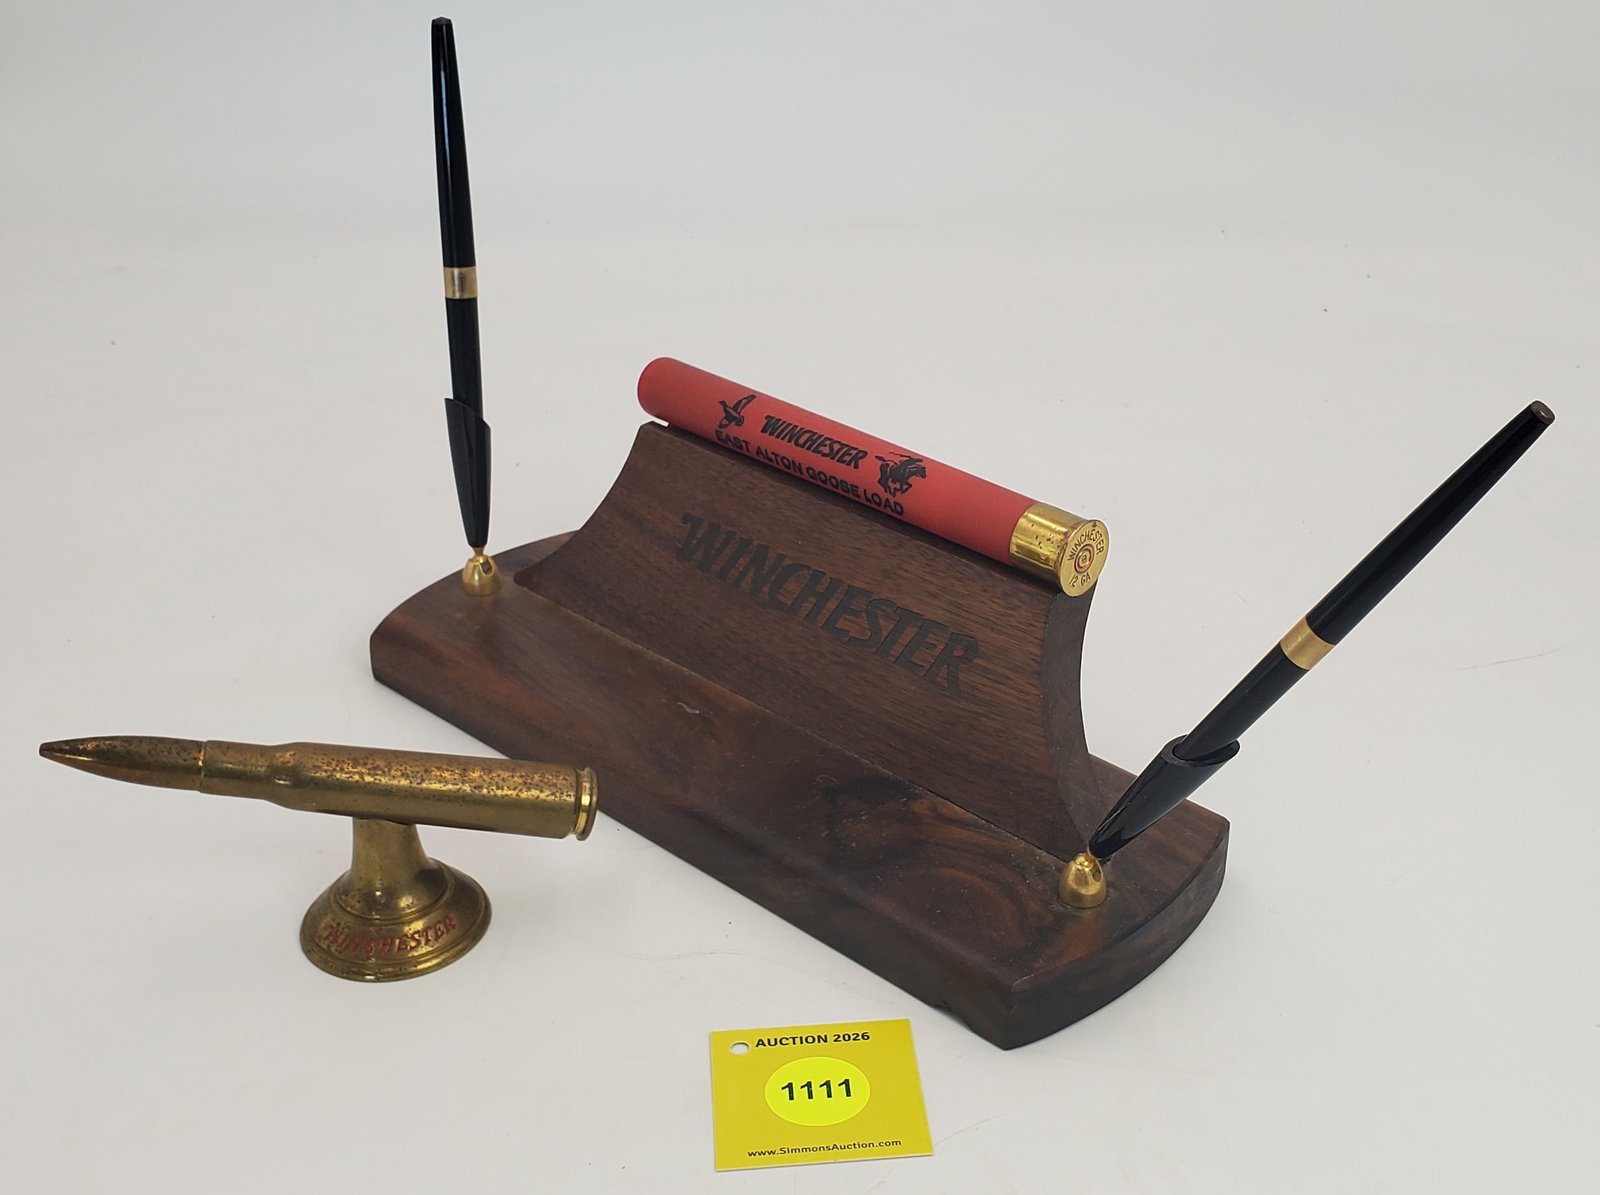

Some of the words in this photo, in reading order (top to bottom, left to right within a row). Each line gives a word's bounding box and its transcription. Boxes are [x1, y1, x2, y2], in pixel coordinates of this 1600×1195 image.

[760, 415, 868, 469] WINCHESTER
[715, 429, 750, 451] EAST
[755, 446, 803, 475] ALTON
[806, 466, 860, 497] GOOSE
[863, 489, 904, 516] LOAD
[1067, 529, 1104, 560] WINCHESTER
[1069, 575, 1079, 587] 12
[673, 512, 979, 696] WINCHESTER
[323, 915, 456, 955] WINCHESTER
[755, 1034, 828, 1048] AUCTION
[833, 1031, 871, 1043] 2026
[781, 1078, 852, 1101] 1111
[748, 1139, 902, 1158] www.SimmonsAuction.com
